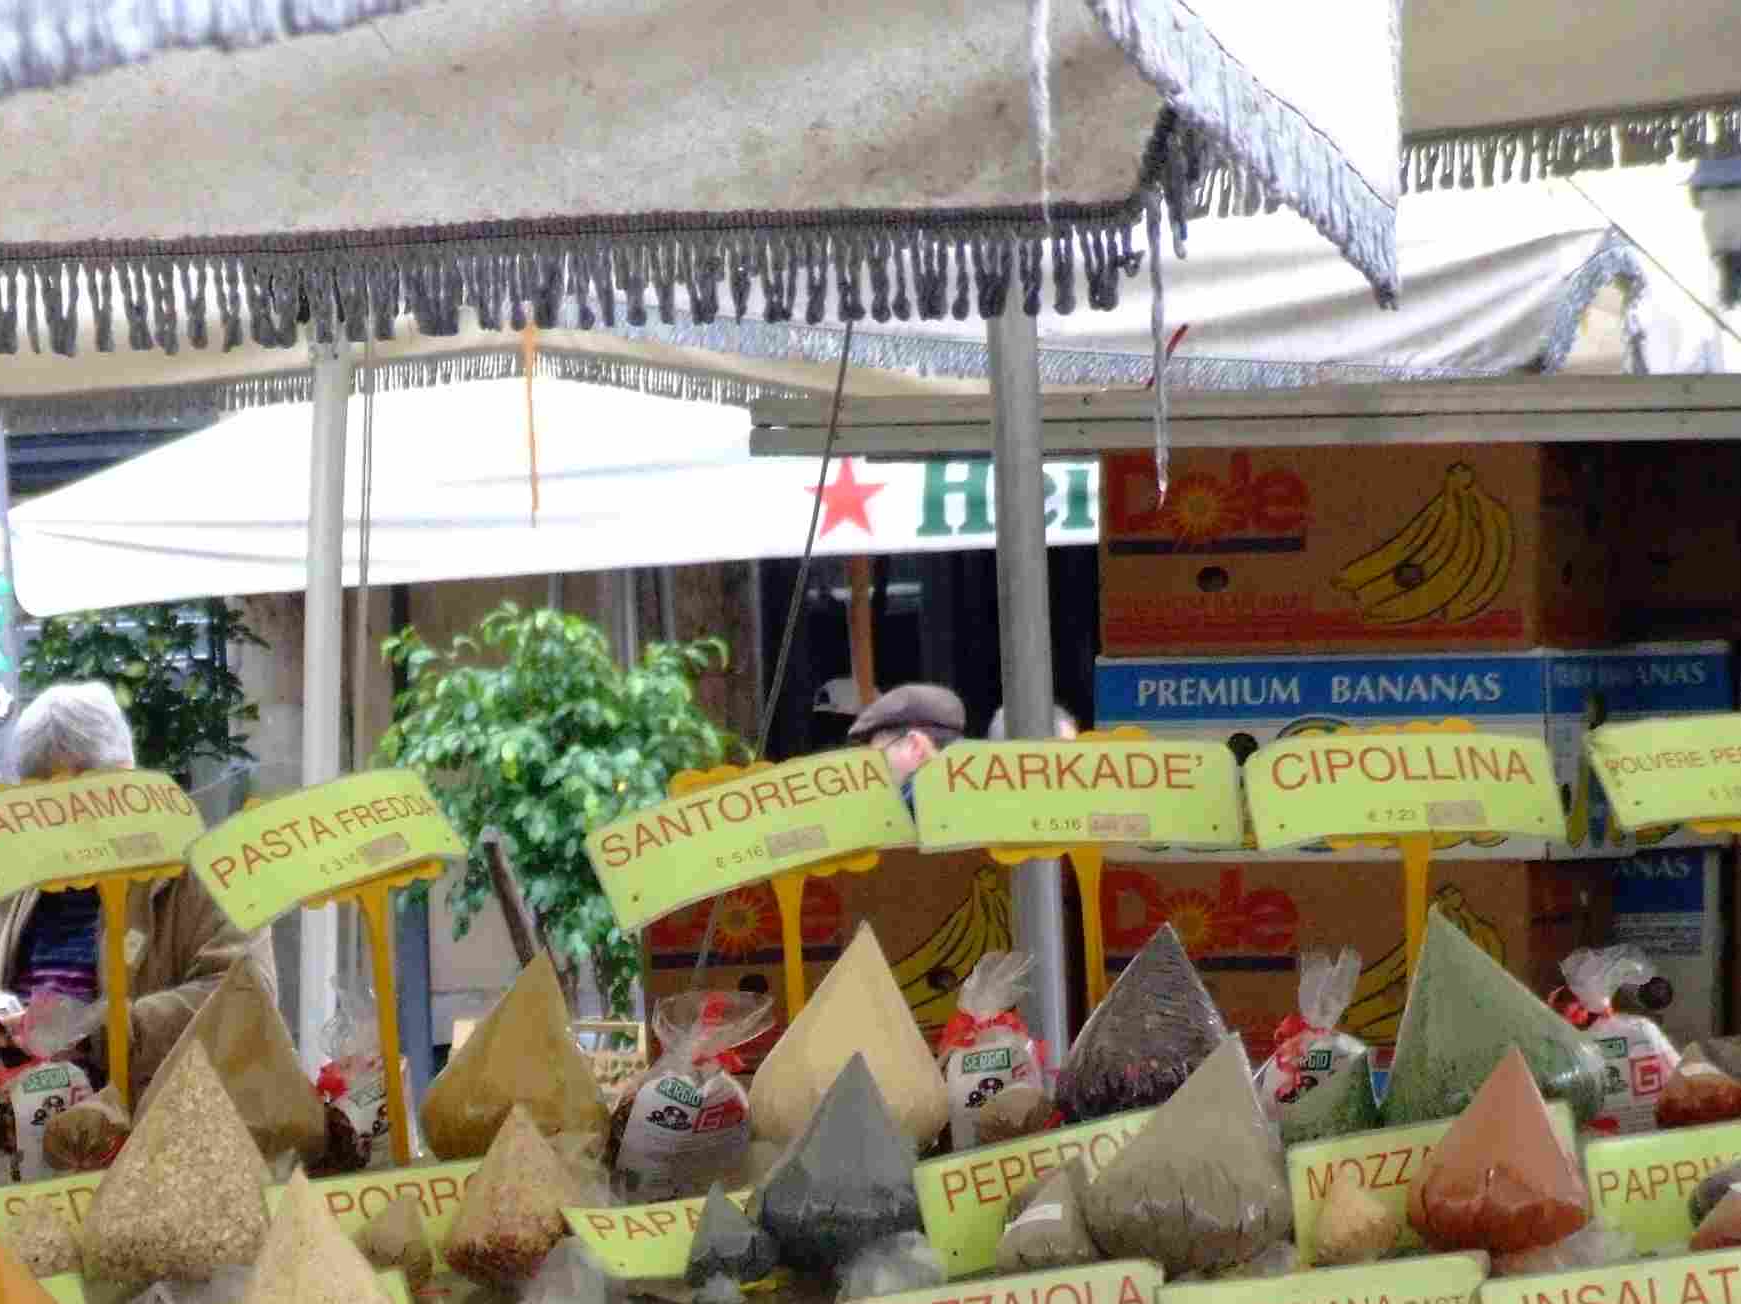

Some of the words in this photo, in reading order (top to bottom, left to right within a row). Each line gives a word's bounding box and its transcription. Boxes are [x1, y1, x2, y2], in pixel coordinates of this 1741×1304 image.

[1137, 676, 1301, 707] PREMIUM
[1331, 673, 1502, 704] BANANAS
[944, 751, 1205, 793] KARKADE'
[1271, 745, 1535, 791] CIPOLLINA
[600, 759, 889, 868] SANTOREGIA
[209, 815, 338, 890] PASTA
[333, 794, 437, 835] FREDDA
[941, 1119, 1148, 1214] PEPERO
[1306, 1145, 1435, 1201] MOZZ
